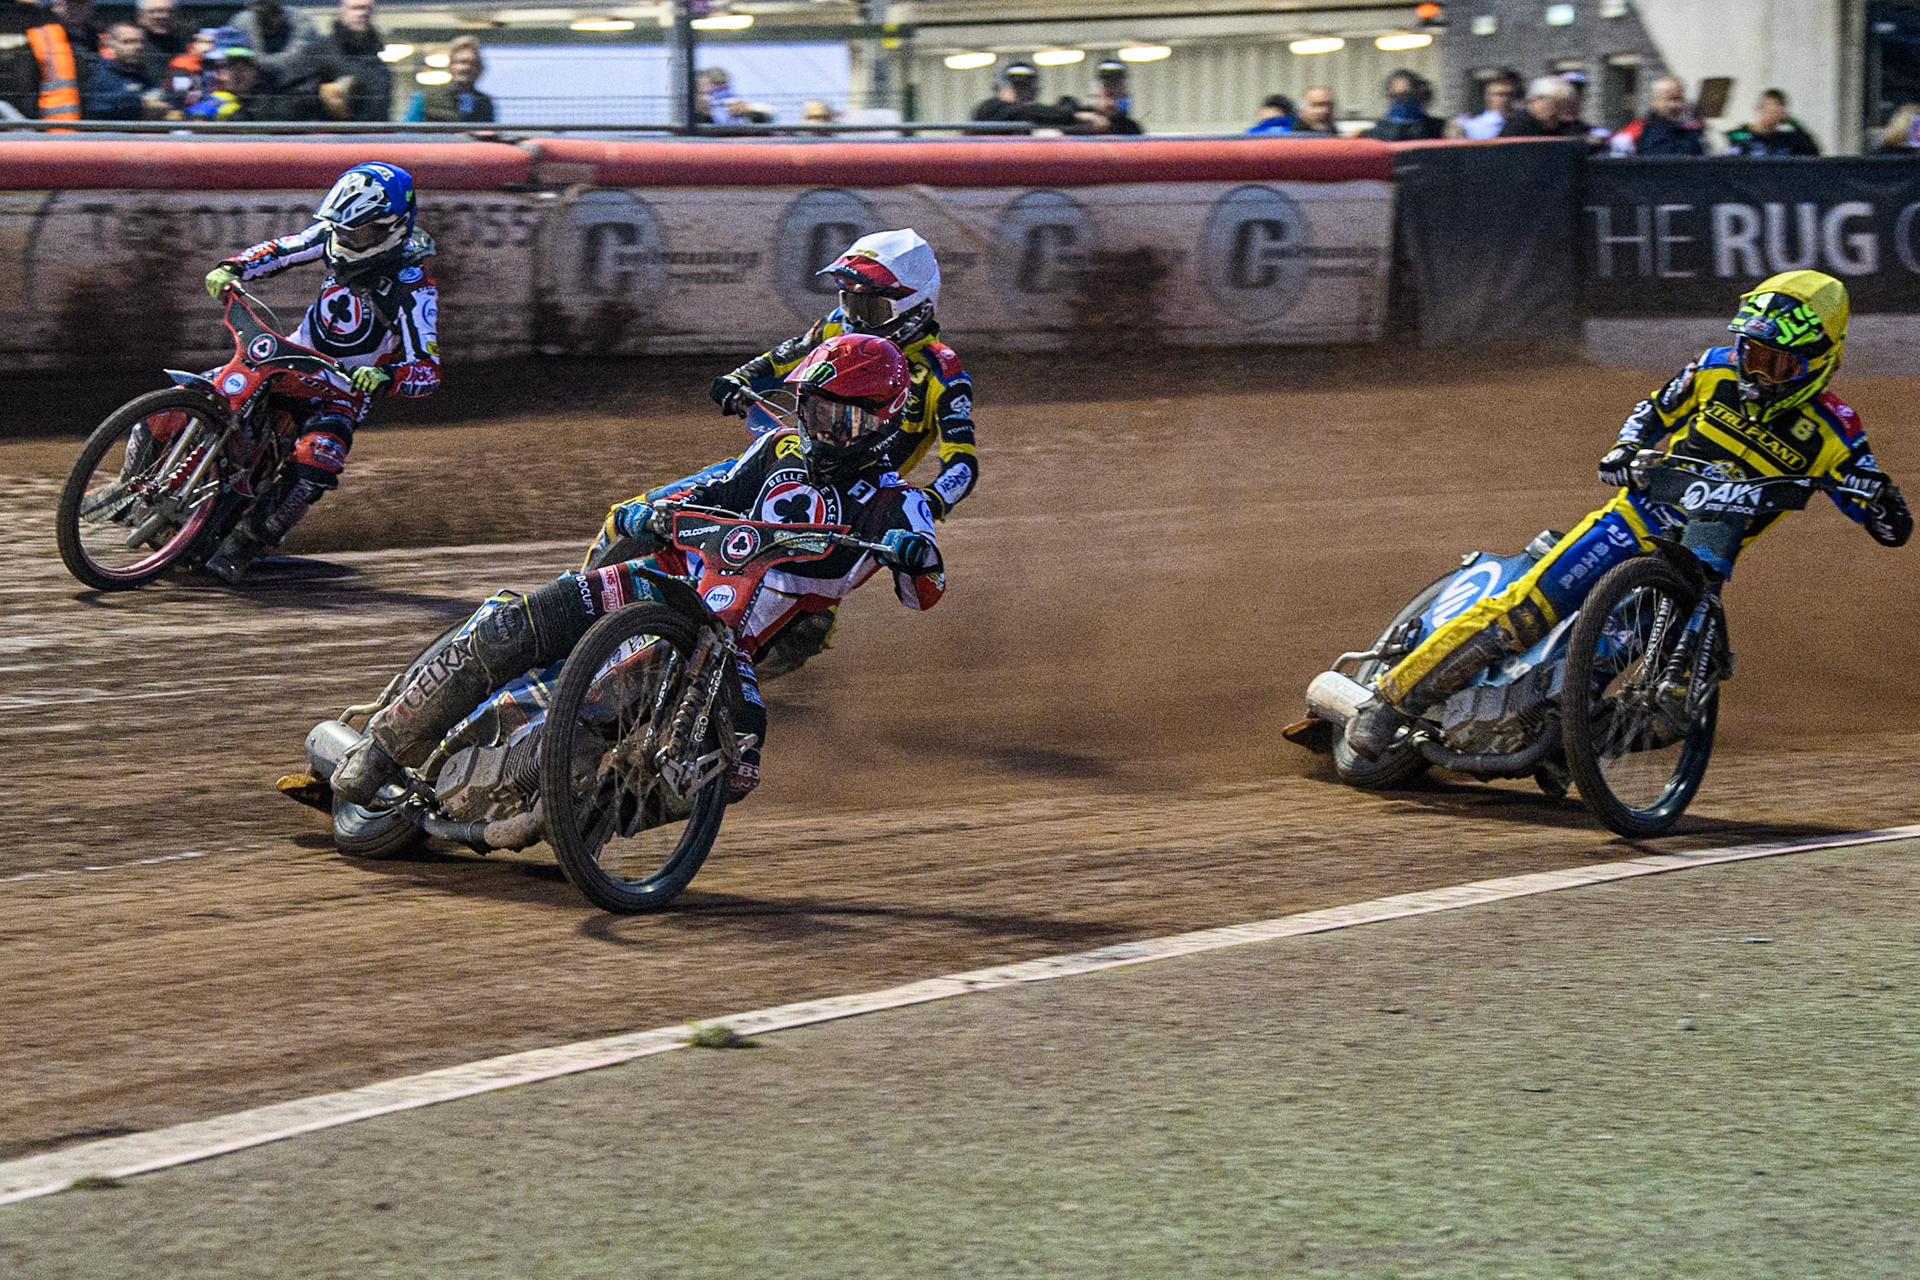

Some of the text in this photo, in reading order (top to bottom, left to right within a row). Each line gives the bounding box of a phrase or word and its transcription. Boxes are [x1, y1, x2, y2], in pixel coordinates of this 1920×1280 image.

[1712, 200, 1879, 277] RUG
[1745, 424, 1801, 467] PLANT
[768, 473, 804, 488] BELLE
[576, 574, 596, 616] DOCUFY
